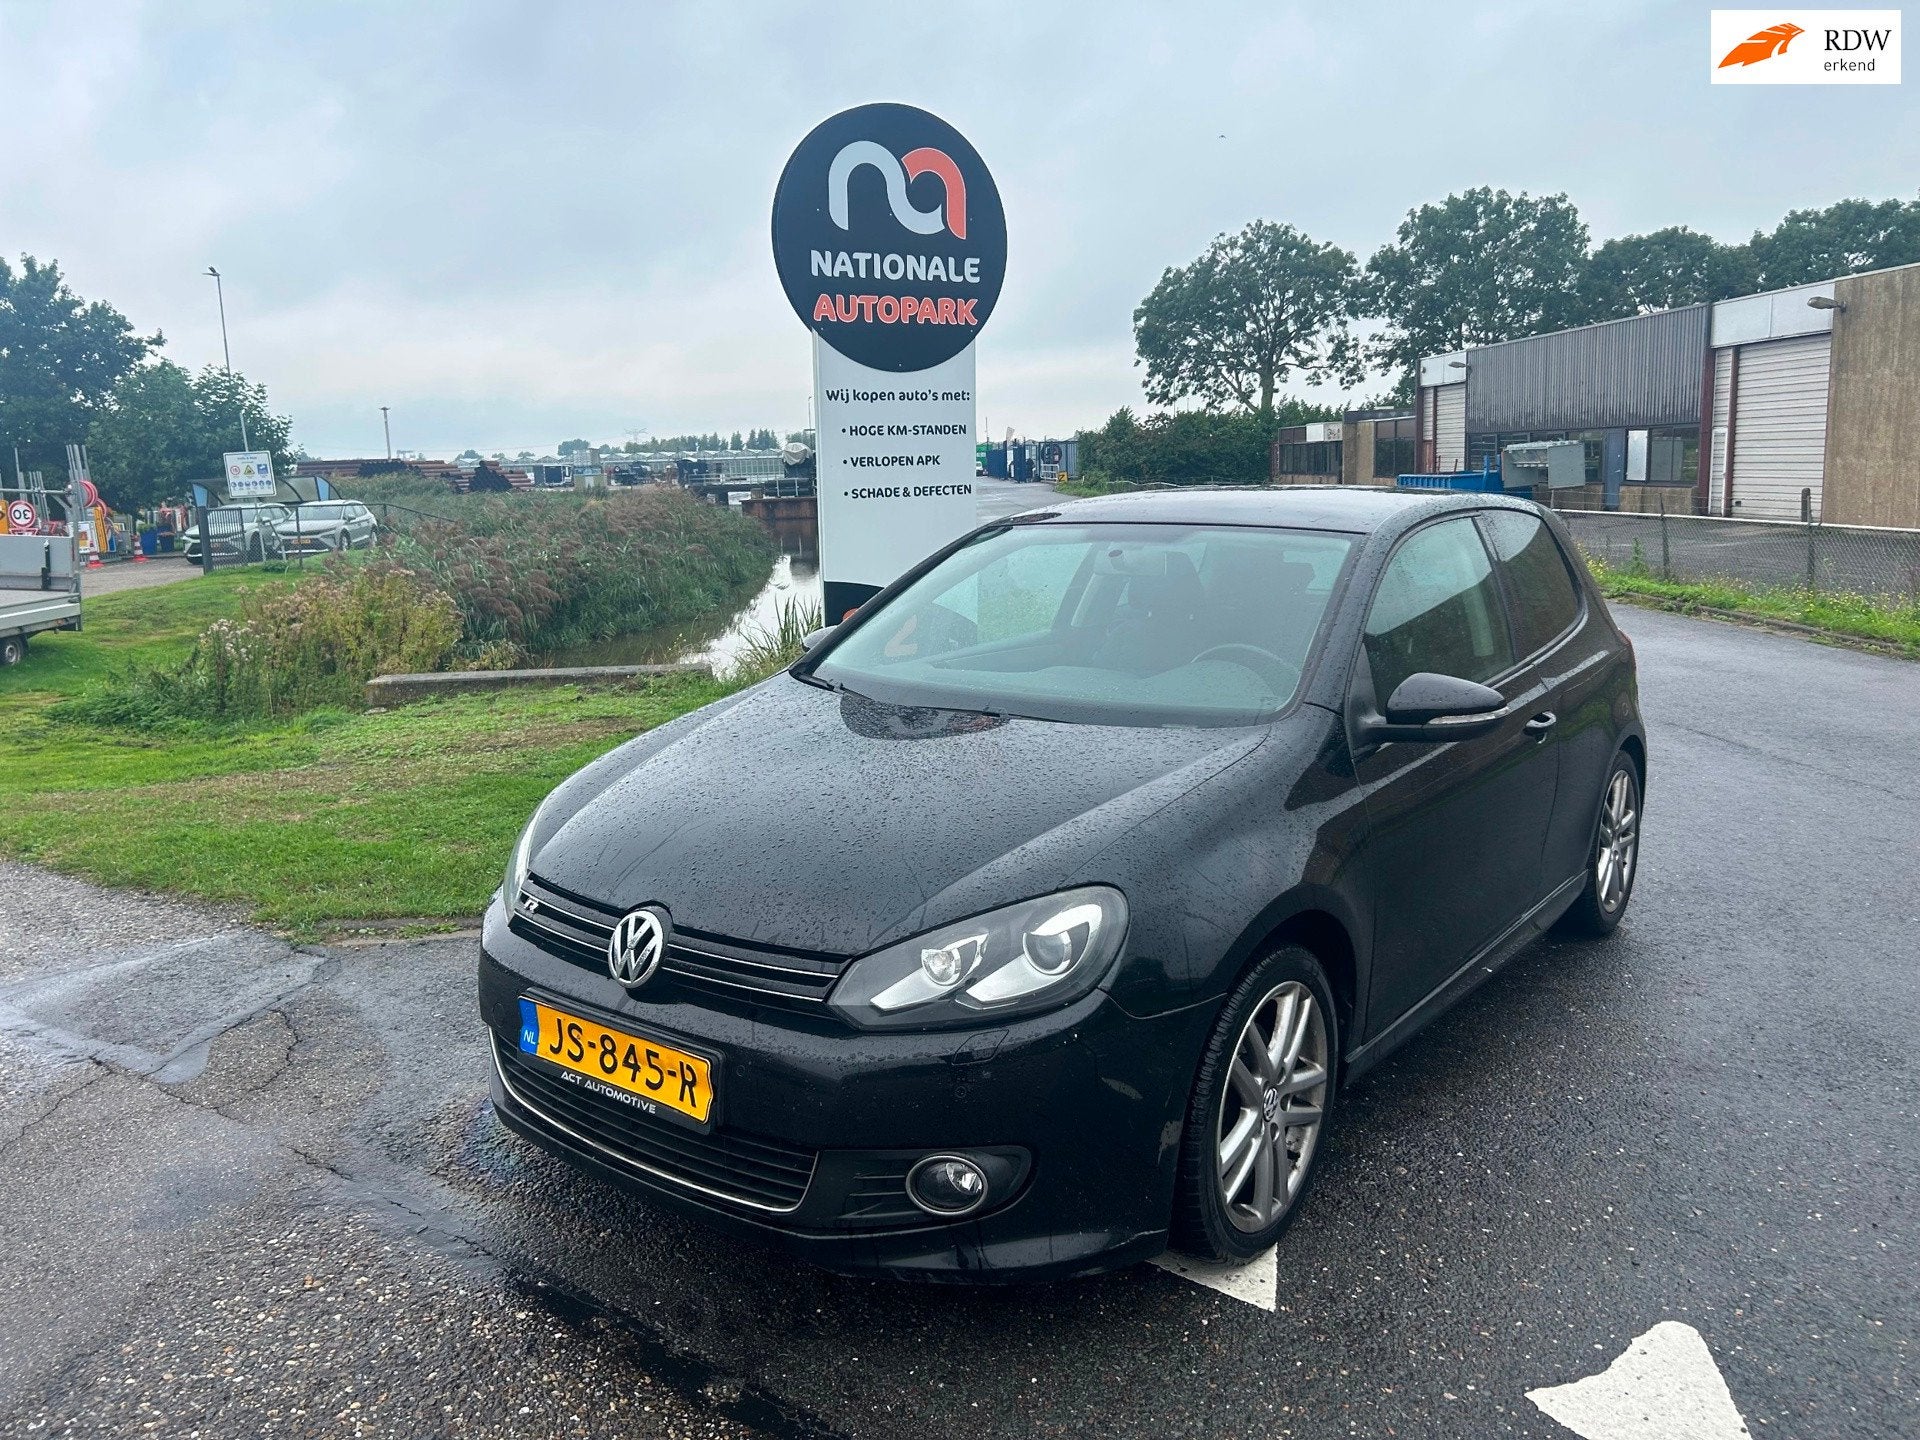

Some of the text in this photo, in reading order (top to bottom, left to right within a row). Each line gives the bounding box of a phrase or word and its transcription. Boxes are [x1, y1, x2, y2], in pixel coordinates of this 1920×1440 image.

[810, 249, 980, 283] NATIONALE
[813, 293, 978, 325] AUTOPARK
[826, 389, 971, 403] Wij kopen auto's met:
[849, 424, 968, 437] HOGE KM-STANDEN
[850, 455, 941, 468] VERLOPEN APK
[851, 484, 973, 500] SCHADE & DEFECTEN
[523, 1029, 537, 1046] NL
[549, 1017, 697, 1109] JS-845-R
[560, 1070, 656, 1114] ACT AUTOMOTIVE
